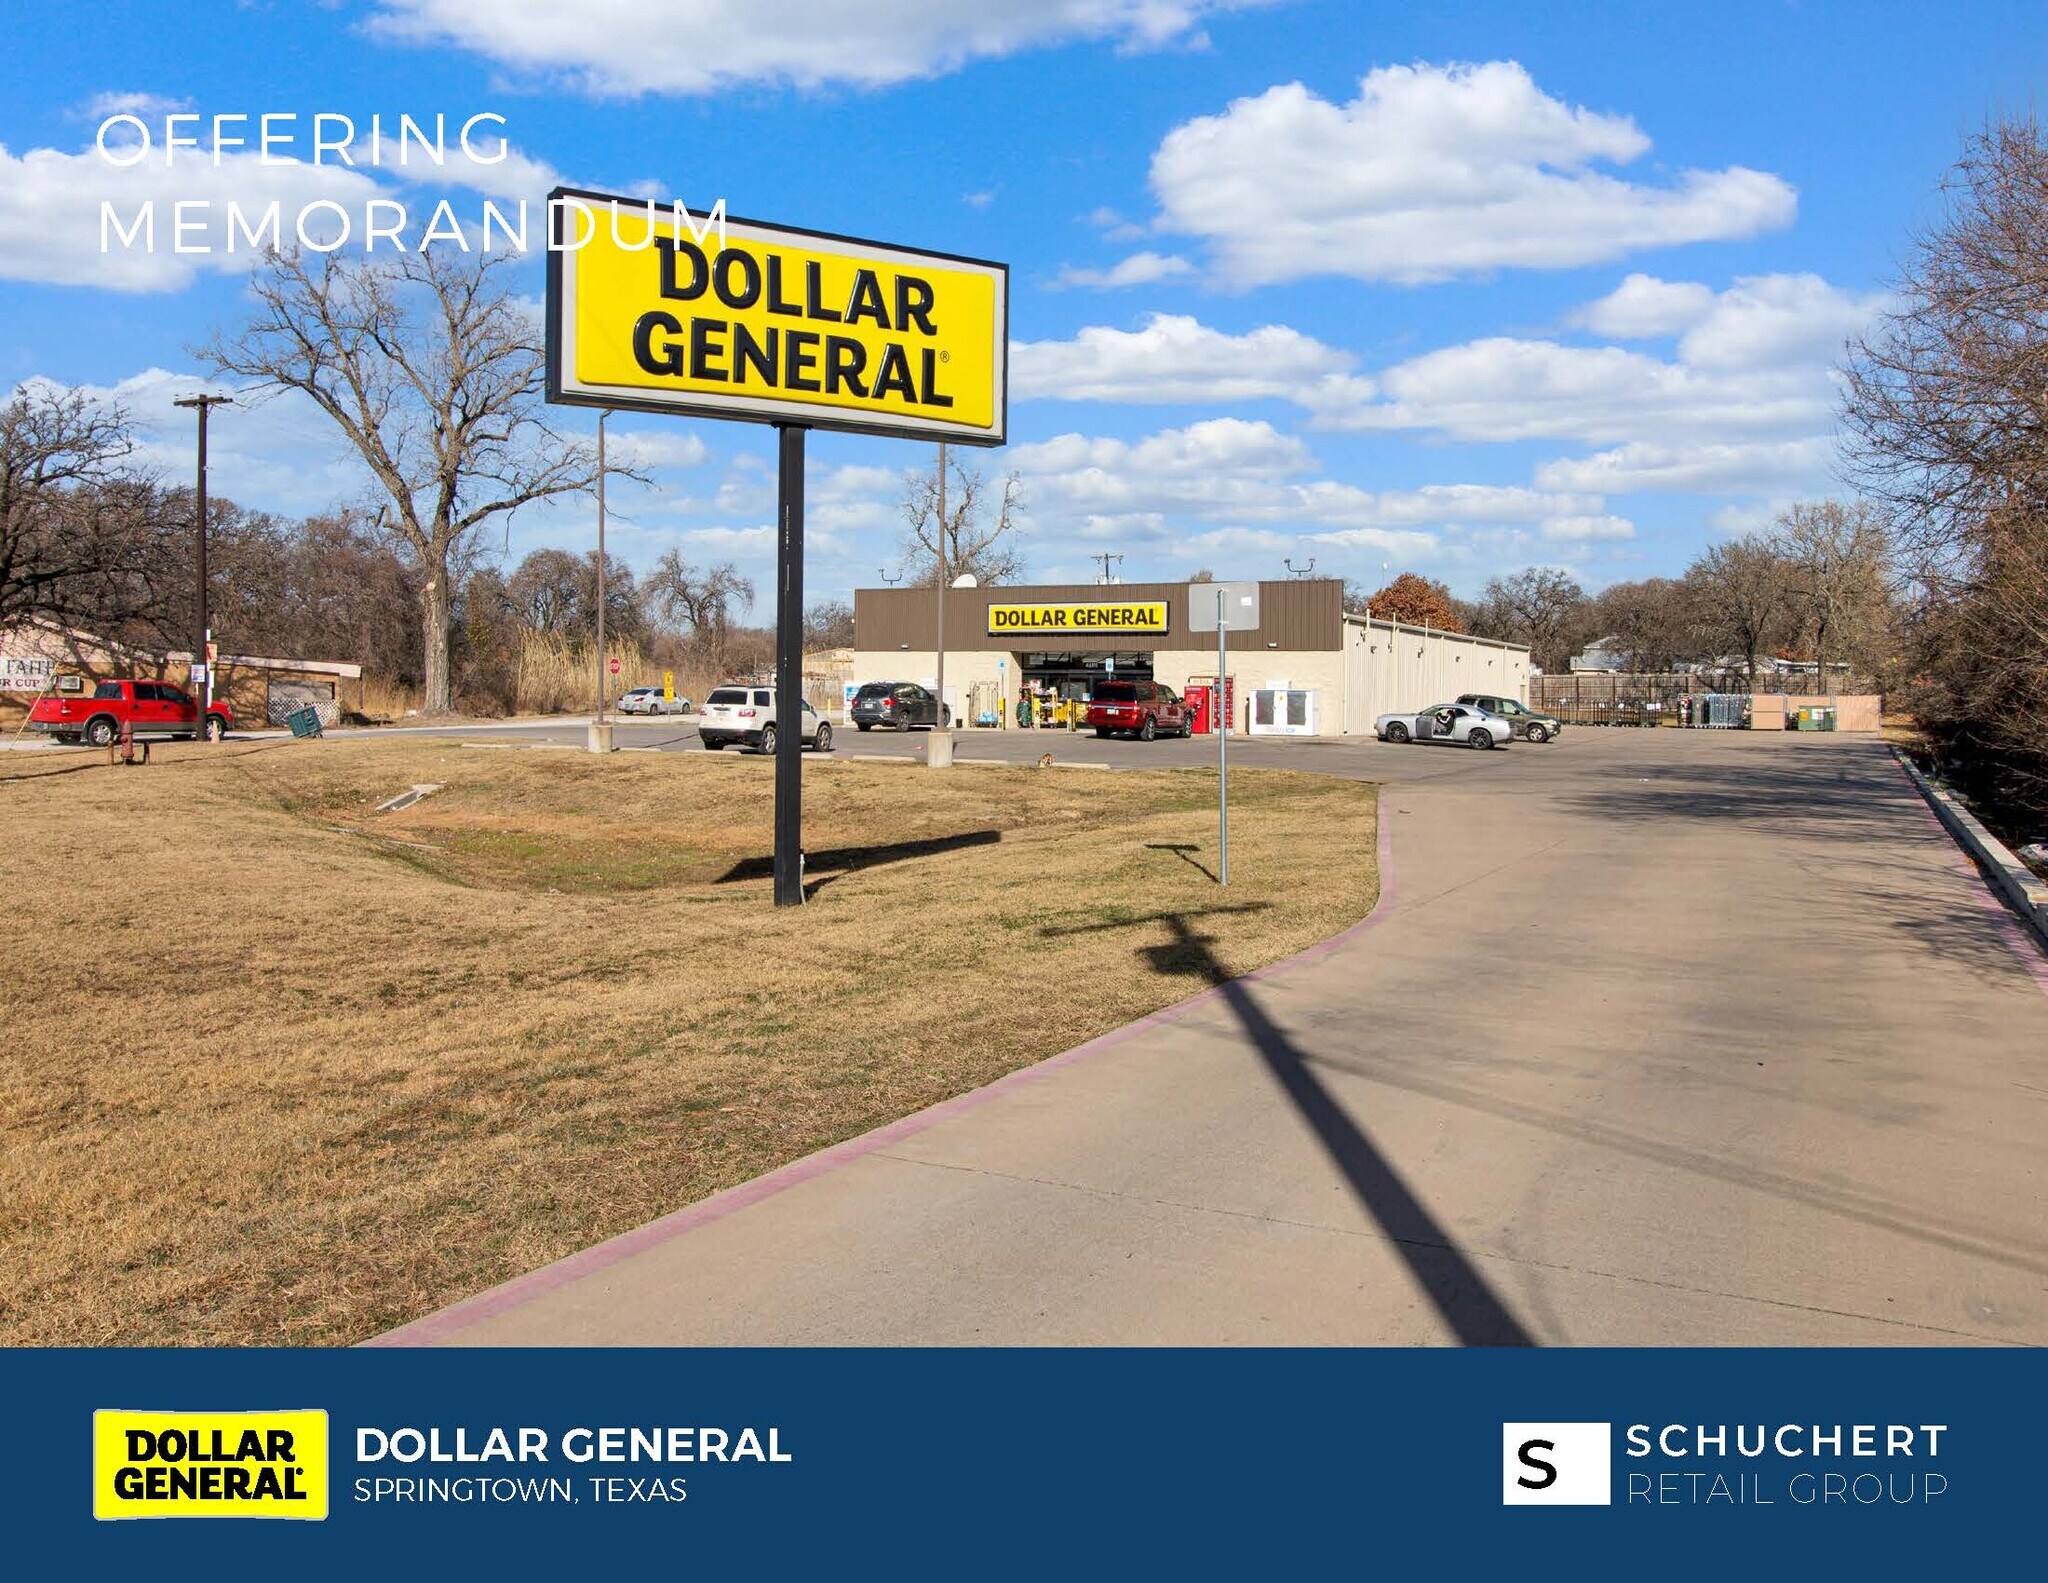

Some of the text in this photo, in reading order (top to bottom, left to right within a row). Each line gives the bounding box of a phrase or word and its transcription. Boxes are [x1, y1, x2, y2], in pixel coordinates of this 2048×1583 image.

[654, 235, 938, 336] DOLLAR
[632, 311, 954, 408] GENERAL
[994, 608, 1160, 627] DOLLAR GENERAL
[15, 679, 40, 687] CUP
